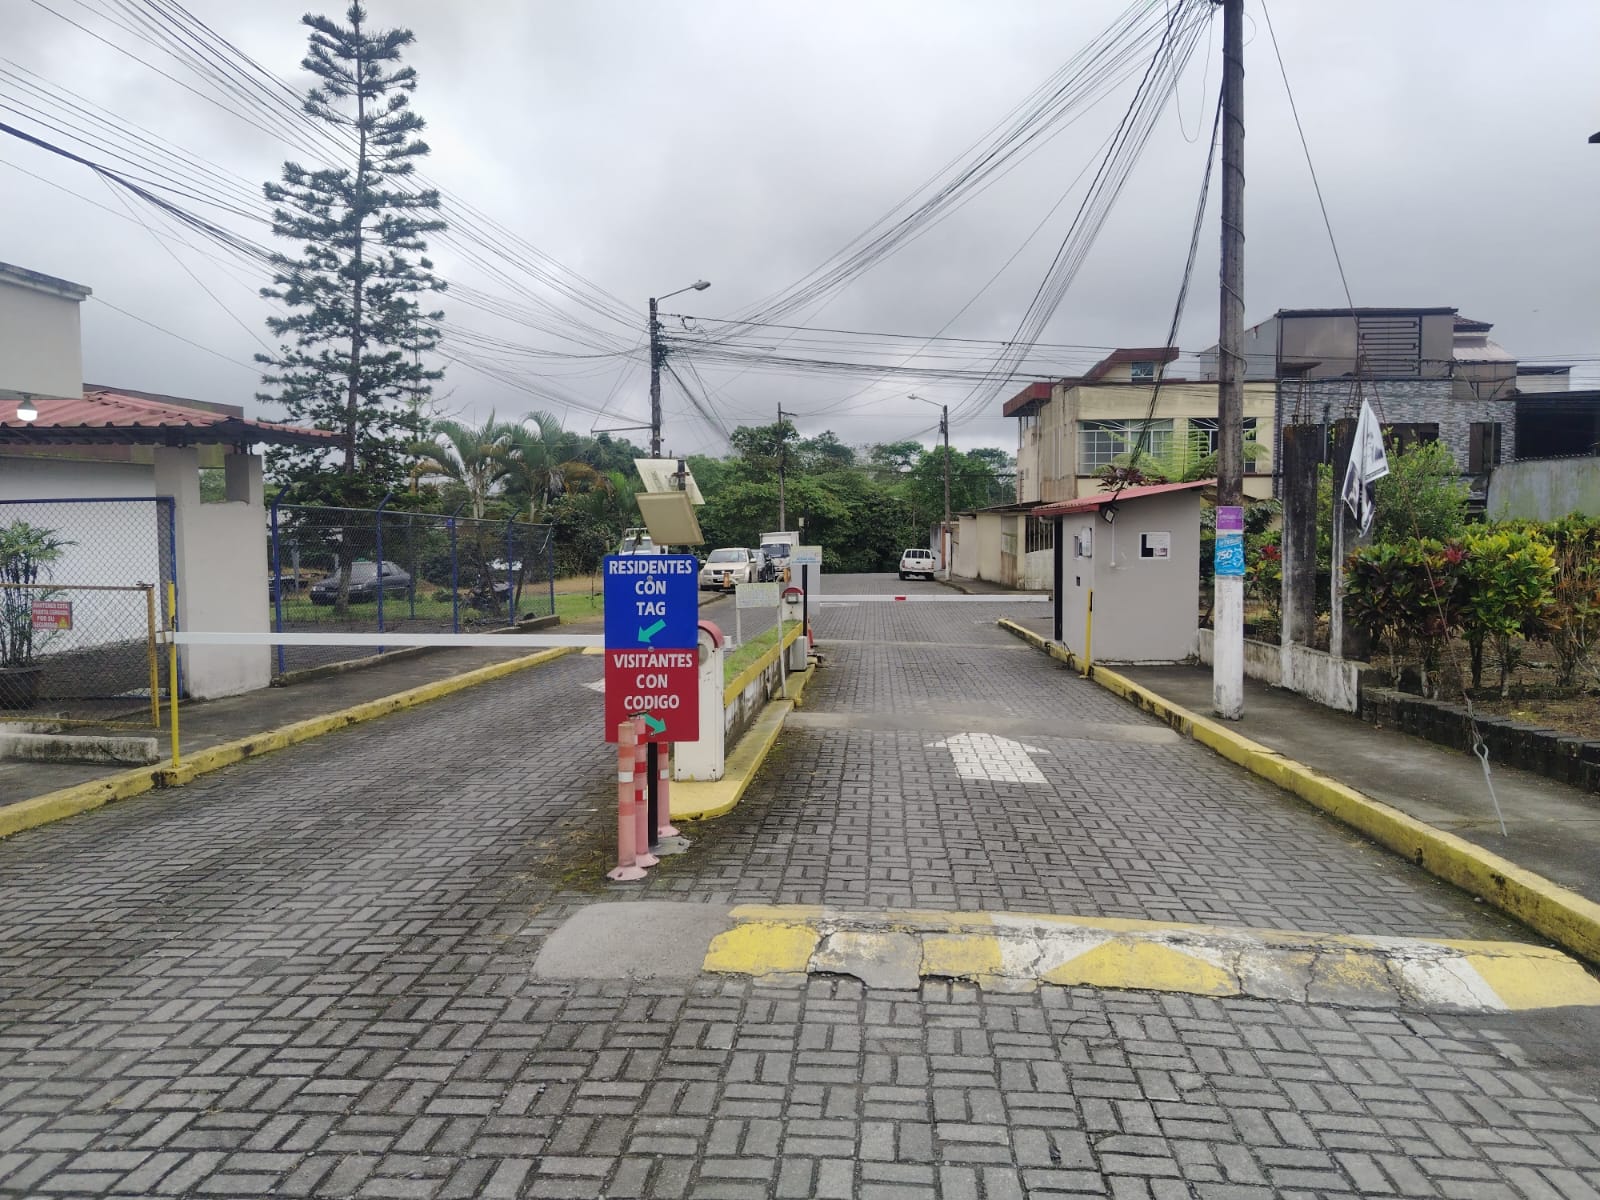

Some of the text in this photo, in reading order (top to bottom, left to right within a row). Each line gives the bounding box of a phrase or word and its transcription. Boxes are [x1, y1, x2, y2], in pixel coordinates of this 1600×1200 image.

[609, 560, 692, 575] RESIDENTES
[635, 581, 666, 595] CON
[636, 602, 666, 616] TAG
[614, 653, 692, 668] VISITANTES
[636, 674, 667, 688] CON
[624, 695, 679, 710] CODIGO
